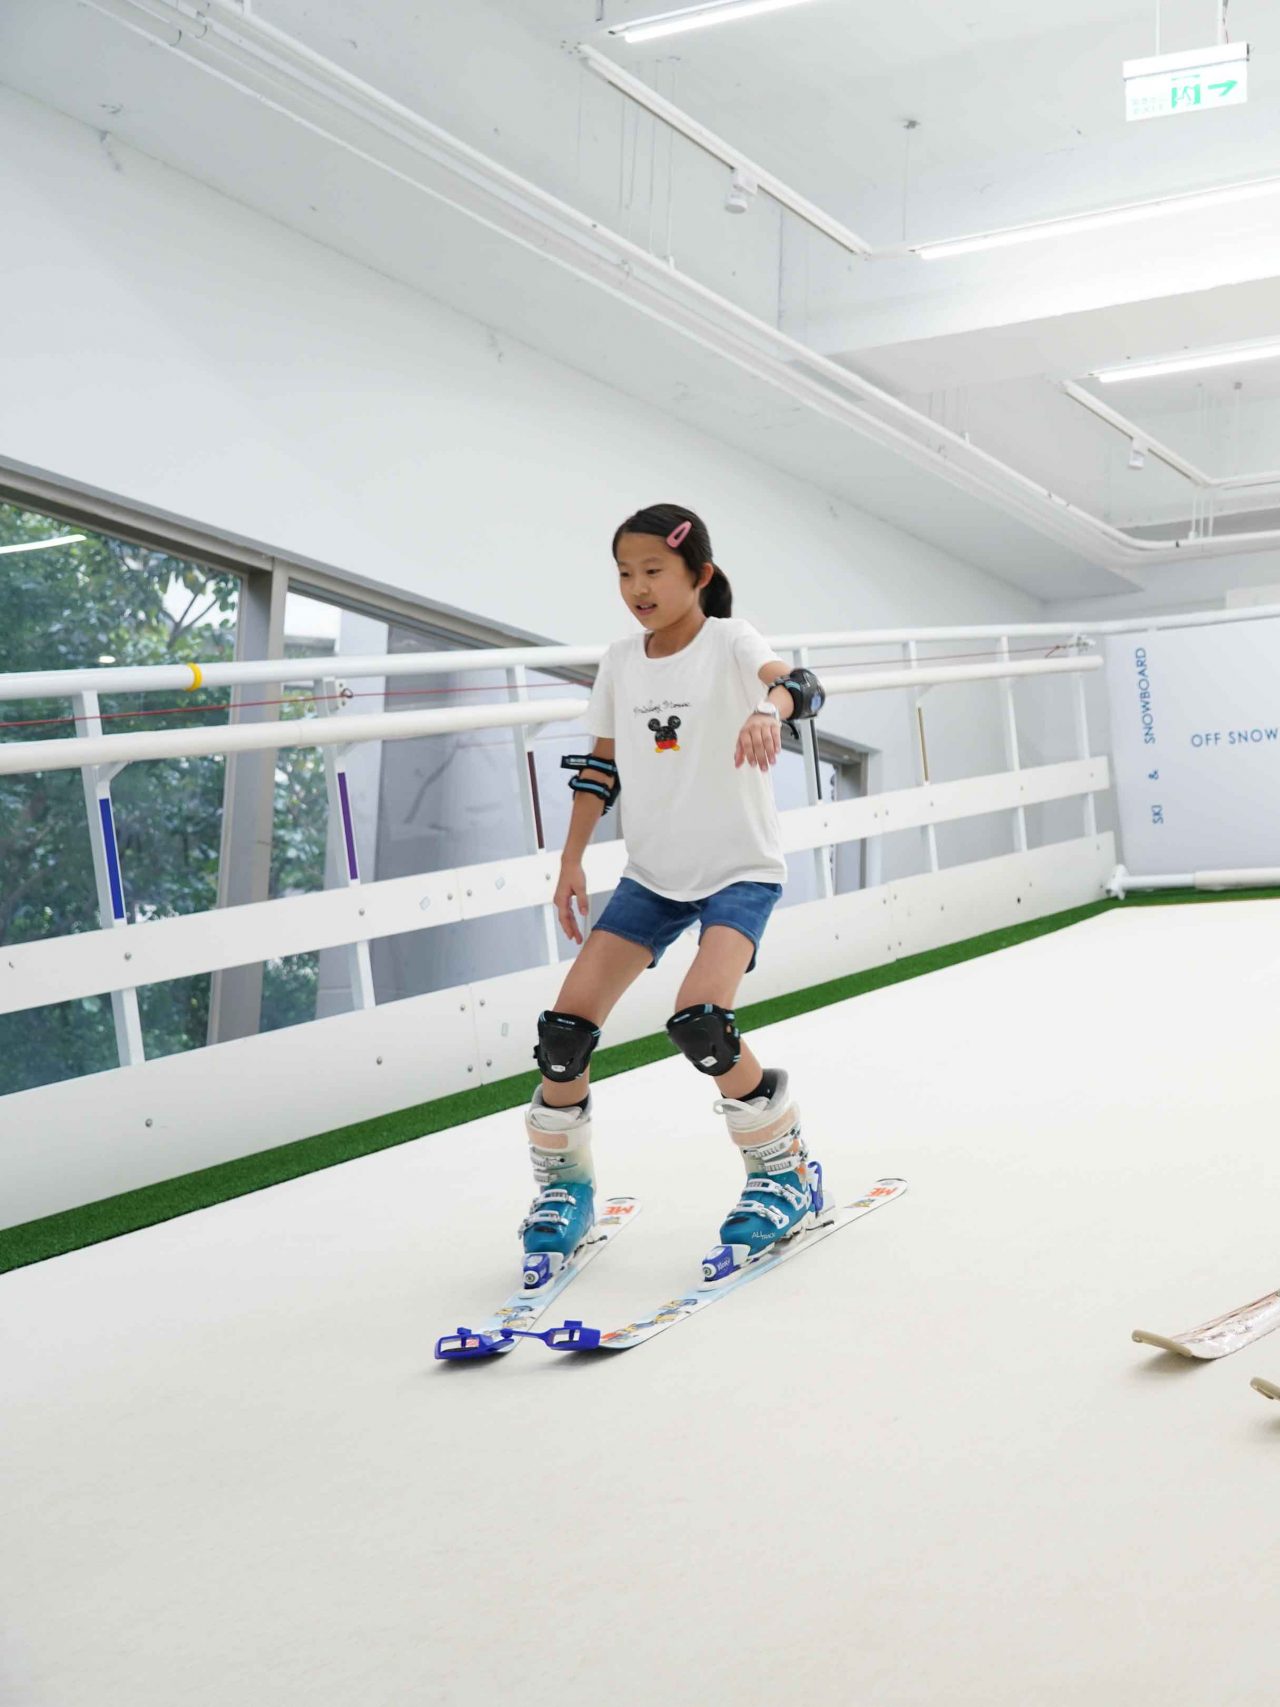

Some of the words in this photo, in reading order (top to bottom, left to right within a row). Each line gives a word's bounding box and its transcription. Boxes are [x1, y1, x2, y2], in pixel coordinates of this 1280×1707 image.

[1135, 647, 1156, 744] SNOWBOARD
[1191, 733, 1221, 747] OFF
[1229, 728, 1279, 745] SNOW
[1148, 769, 1159, 780] &
[1151, 804, 1164, 824] SKI
